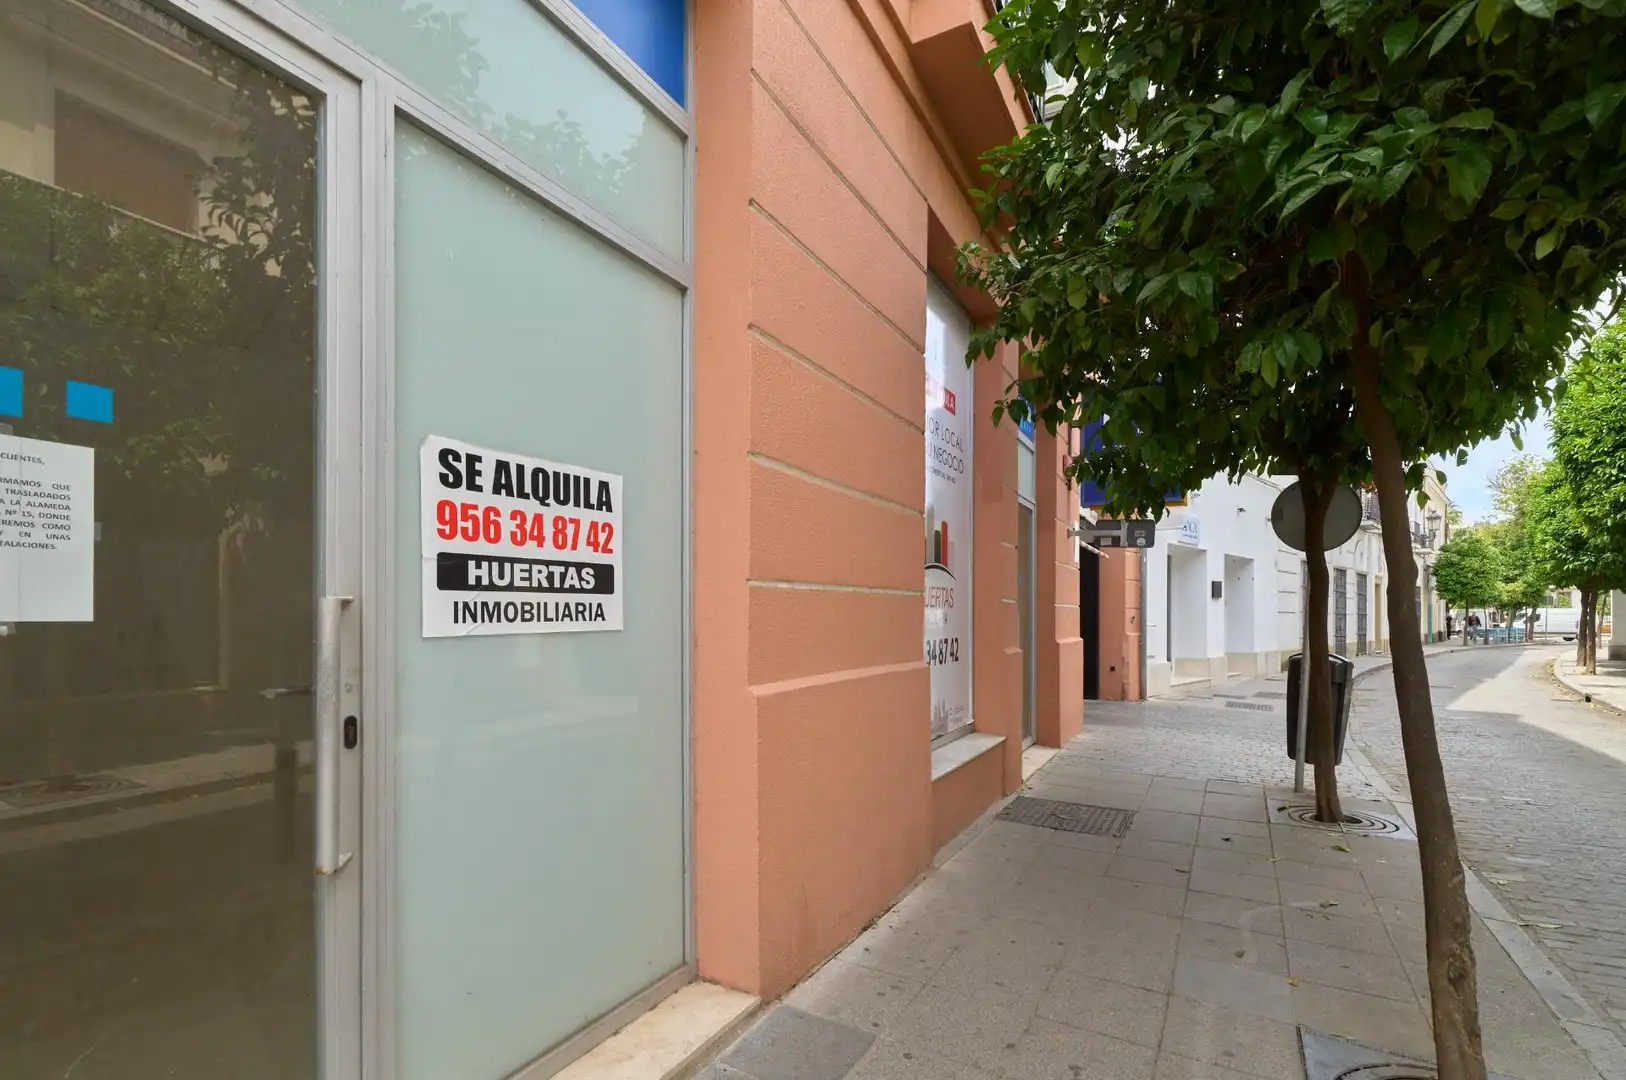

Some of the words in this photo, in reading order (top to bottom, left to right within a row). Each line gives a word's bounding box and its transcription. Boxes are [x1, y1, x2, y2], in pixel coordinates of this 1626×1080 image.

[941, 424, 964, 452] LOCAL
[52, 483, 71, 491] QUE
[438, 448, 484, 493] SE
[491, 459, 614, 513] ALQUILA
[5, 488, 71, 501] TRASLADADOS
[26, 500, 71, 511] ALAMEDA
[0, 519, 36, 529] REMOS
[41, 522, 71, 531] COMO
[38, 512, 71, 521] DONDE
[436, 499, 502, 544] 956
[509, 509, 546, 548] 34
[552, 515, 581, 551] 87
[585, 520, 614, 554] 42
[46, 533, 71, 541] UNAS
[467, 560, 596, 590] HUERTAS
[453, 600, 606, 624] INMOBILIARIA
[926, 639, 938, 666] 34
[938, 638, 949, 665] 87
[949, 637, 960, 663] 42
